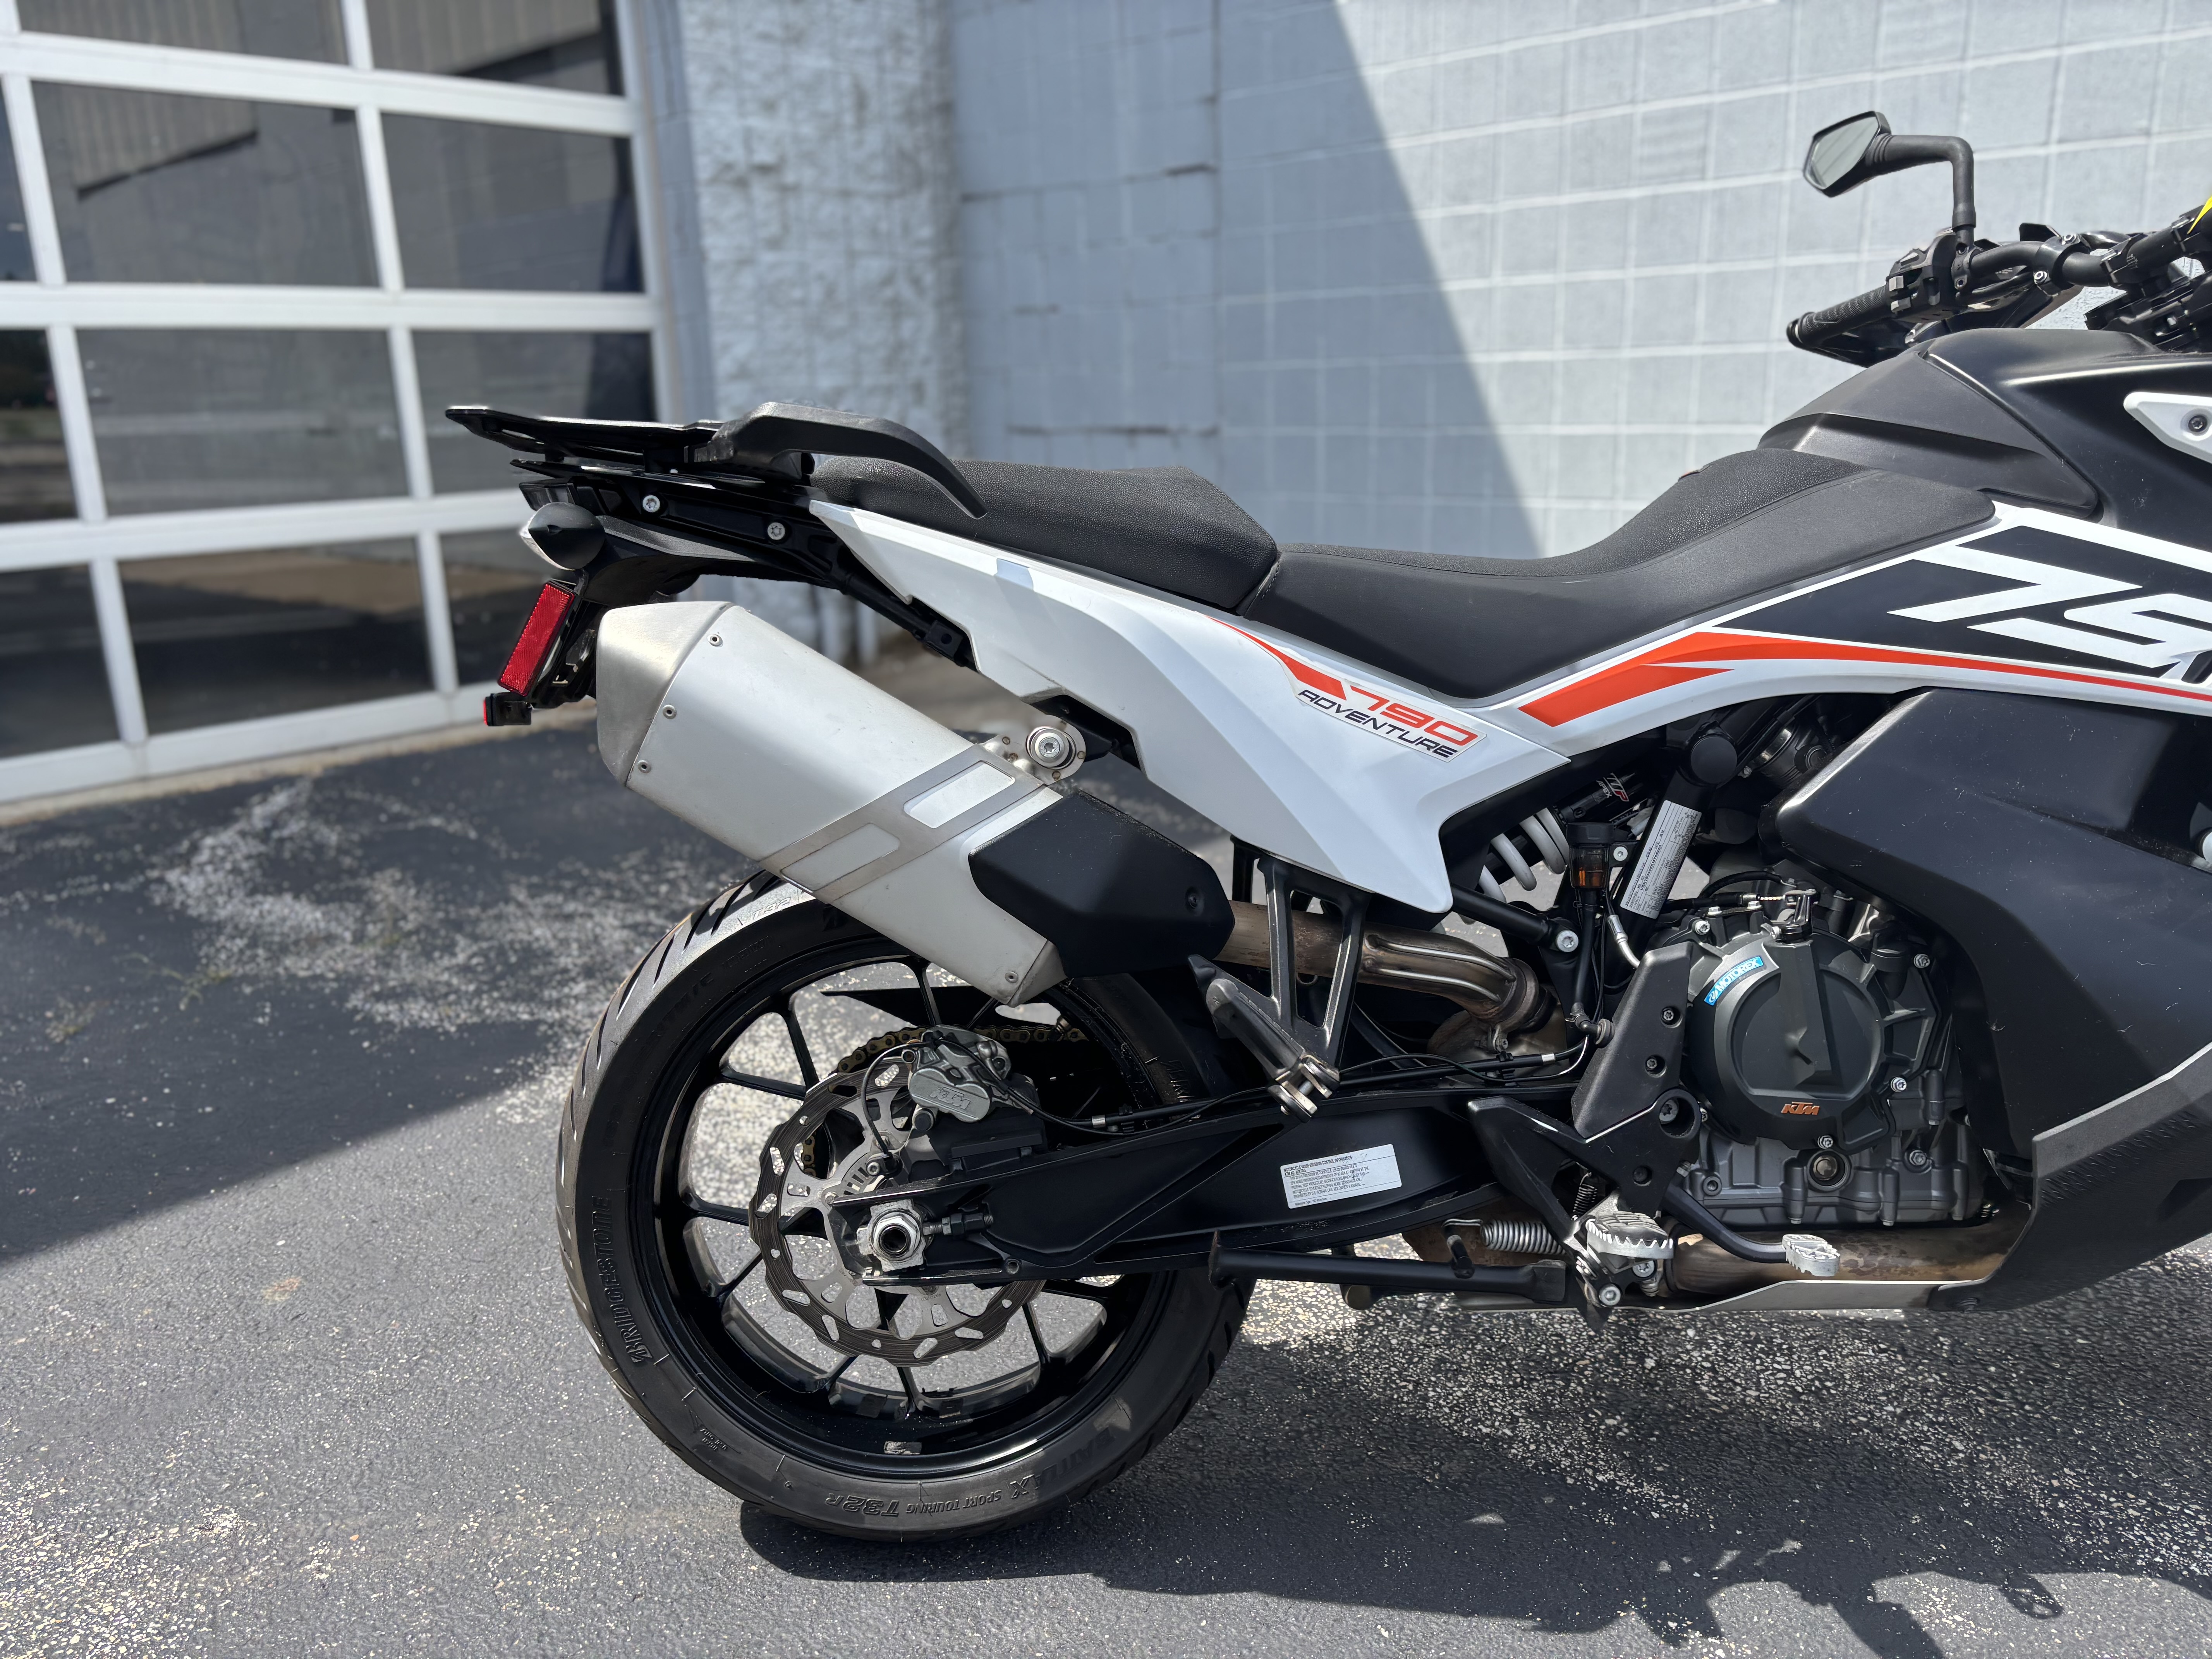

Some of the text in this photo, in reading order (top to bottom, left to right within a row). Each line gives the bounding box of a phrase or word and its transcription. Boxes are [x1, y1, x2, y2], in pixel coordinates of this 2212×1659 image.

[1298, 689, 1458, 758] ADVENTURE
[1350, 685, 1479, 747] 790
[1596, 780, 1612, 799] APEX
[752, 898, 791, 920] T32
[1716, 958, 1760, 992] MOTOREX
[930, 1087, 971, 1110] KTM
[1781, 1101, 1820, 1115] KTM
[592, 1195, 653, 1364] BRIDGESTONE
[905, 1499, 960, 1515] TOURING
[962, 1490, 1002, 1509] SPORT
